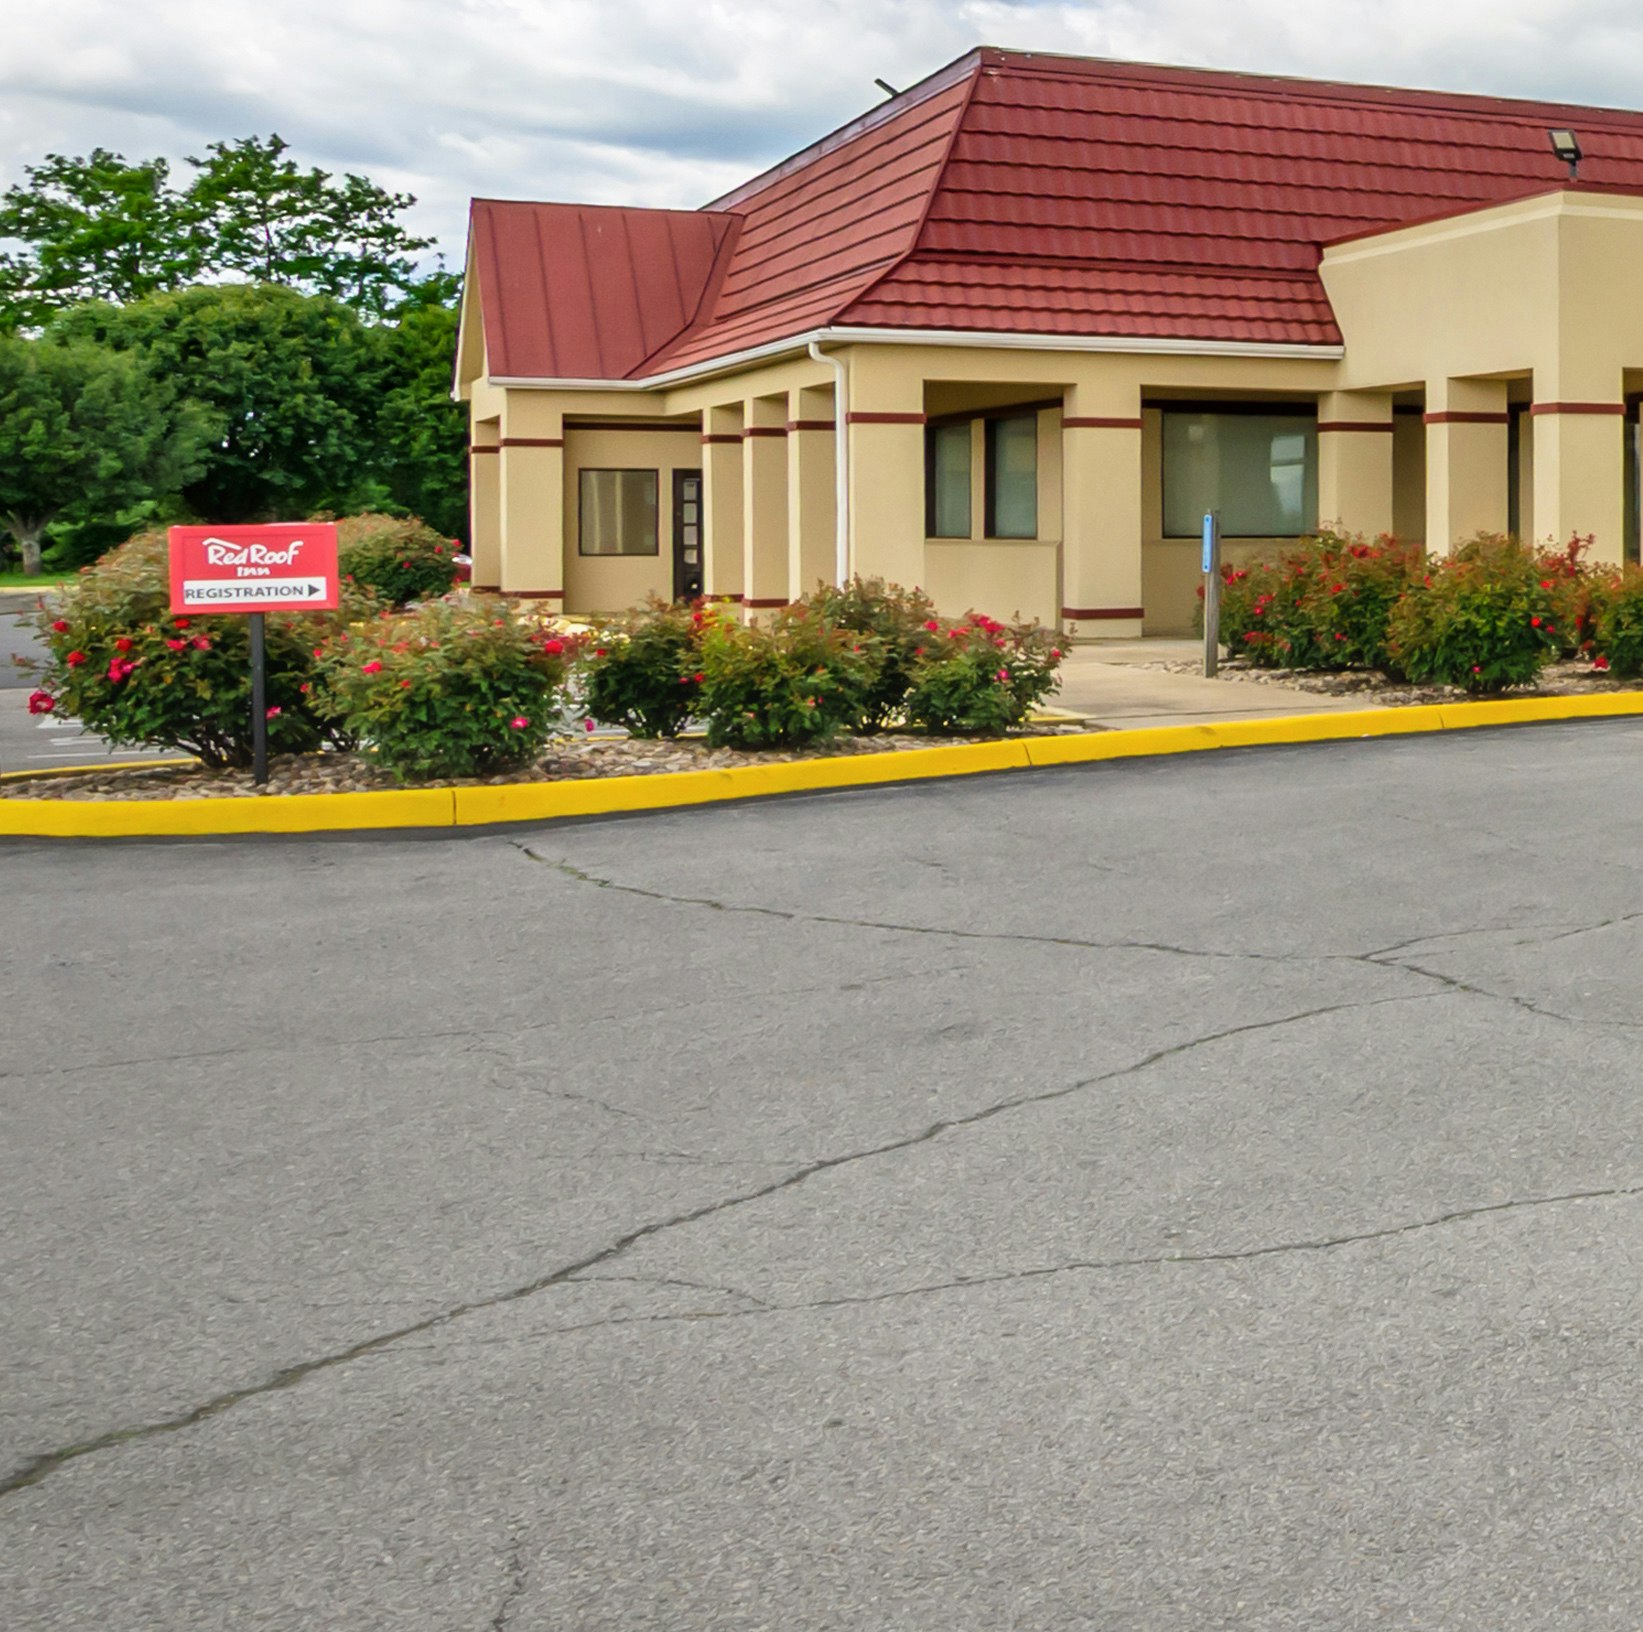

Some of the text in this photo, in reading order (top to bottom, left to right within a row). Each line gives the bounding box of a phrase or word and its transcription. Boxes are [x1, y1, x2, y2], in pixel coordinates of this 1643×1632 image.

[207, 540, 304, 566] Red Roof
[184, 585, 304, 599] REGISTRATION
